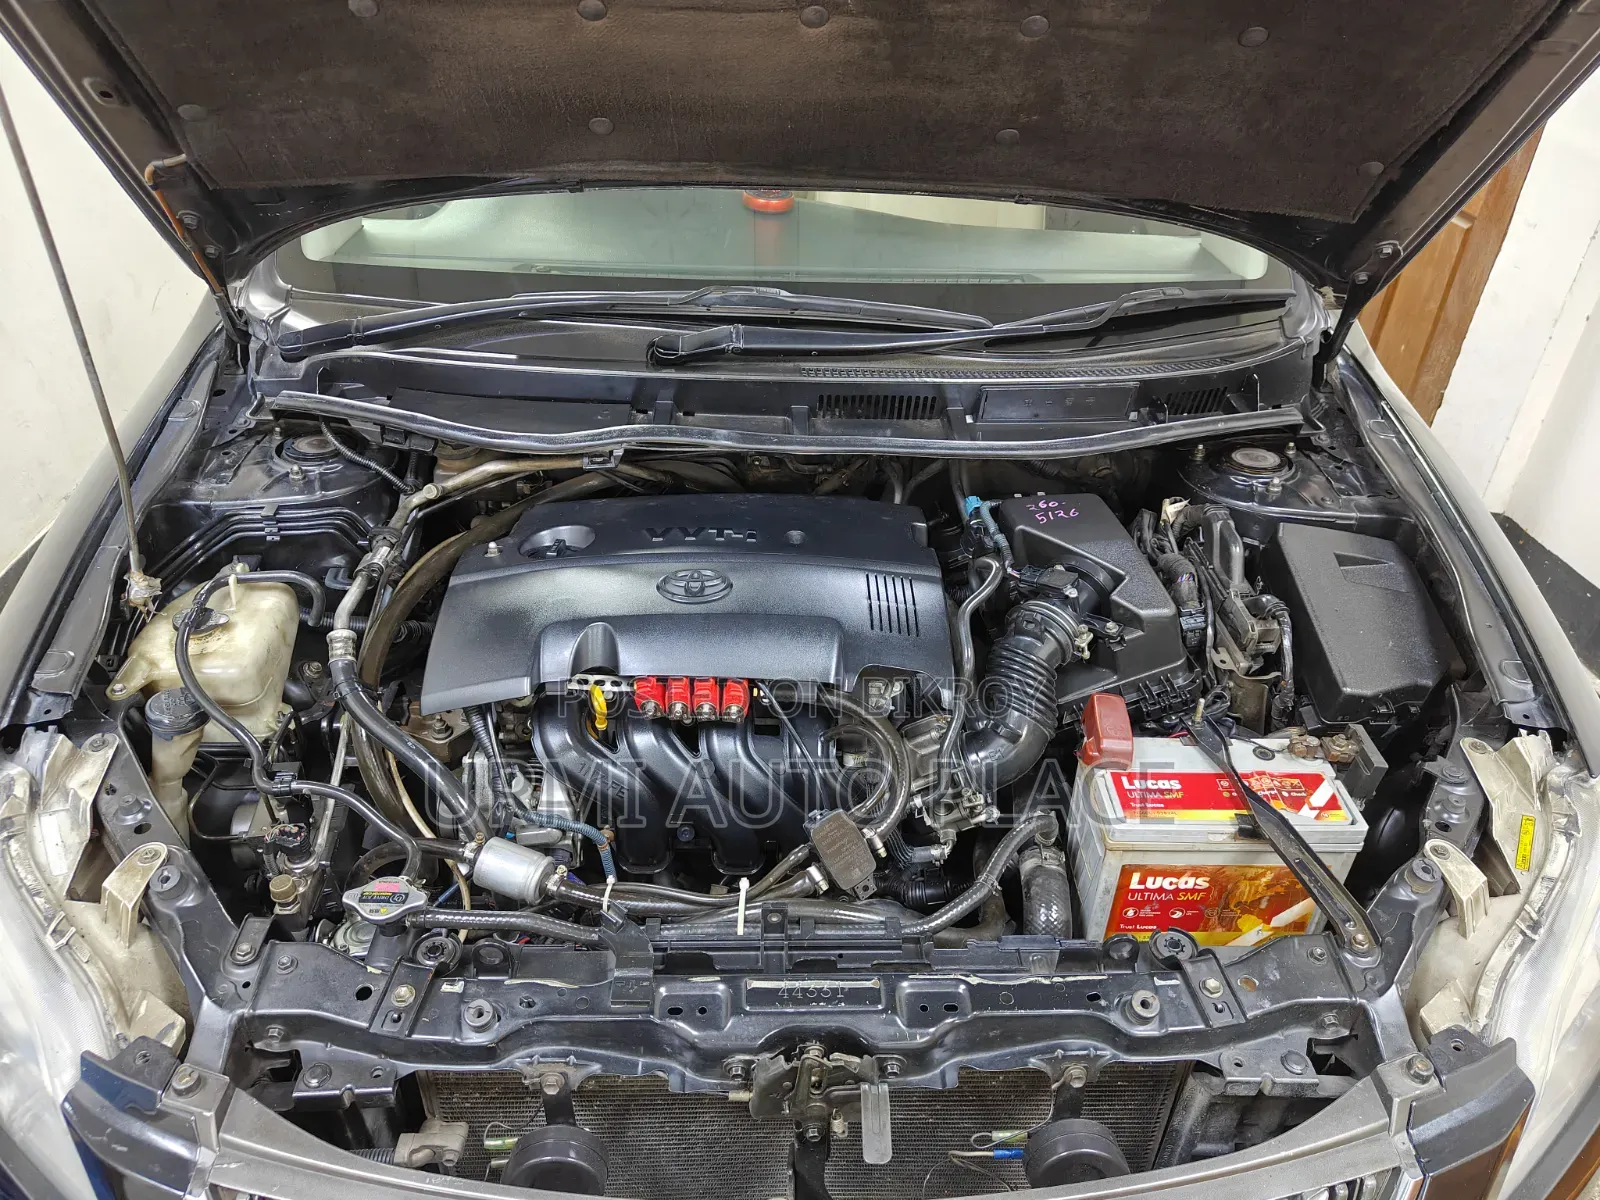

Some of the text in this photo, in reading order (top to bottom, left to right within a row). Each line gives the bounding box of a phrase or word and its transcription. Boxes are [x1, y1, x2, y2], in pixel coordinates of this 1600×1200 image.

[1035, 508, 1079, 524] 5126
[1121, 775, 1182, 790] Lucas
[1127, 791, 1184, 799] ULTIMA SMF
[1128, 872, 1211, 890] Lucas
[1127, 891, 1207, 901] ULTIMA SMF
